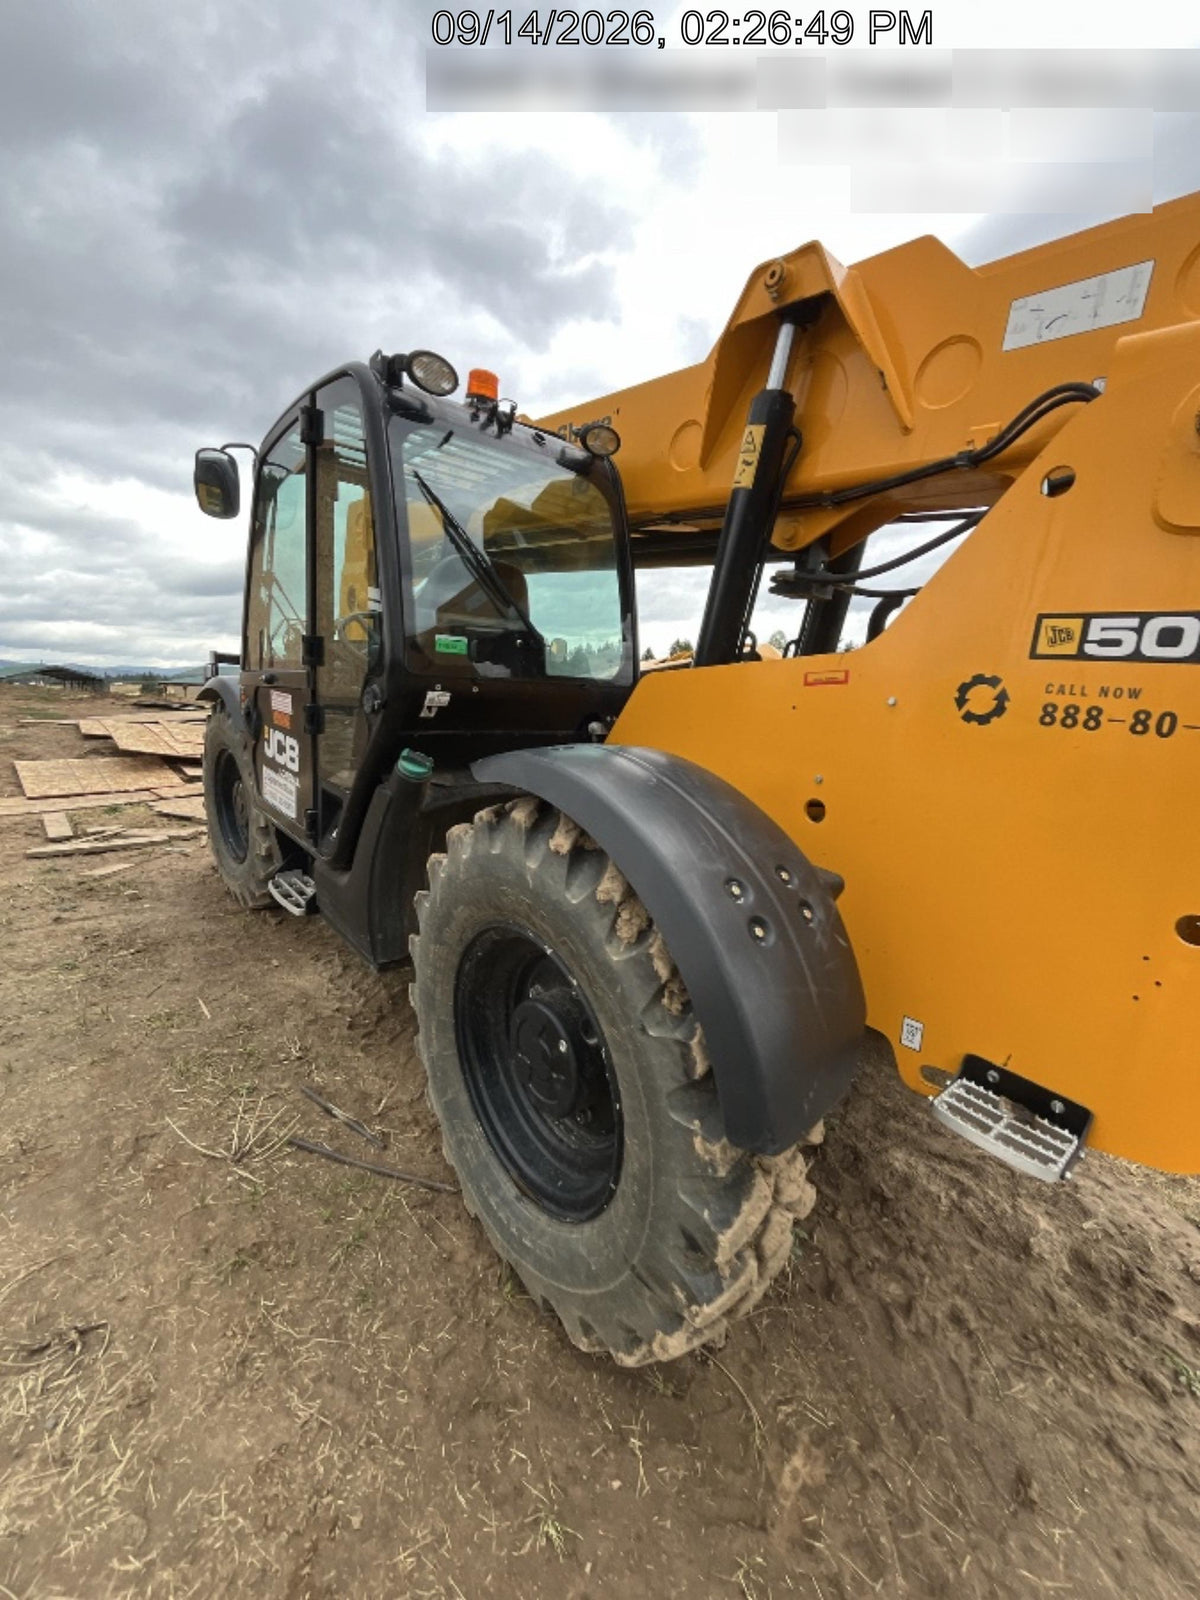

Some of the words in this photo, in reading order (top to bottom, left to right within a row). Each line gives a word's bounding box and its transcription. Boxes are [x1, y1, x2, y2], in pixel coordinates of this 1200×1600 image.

[1046, 625, 1075, 648] JCB
[1044, 683, 1088, 698] CALL
[1098, 685, 1143, 700] NOW
[263, 727, 300, 773] JCB
